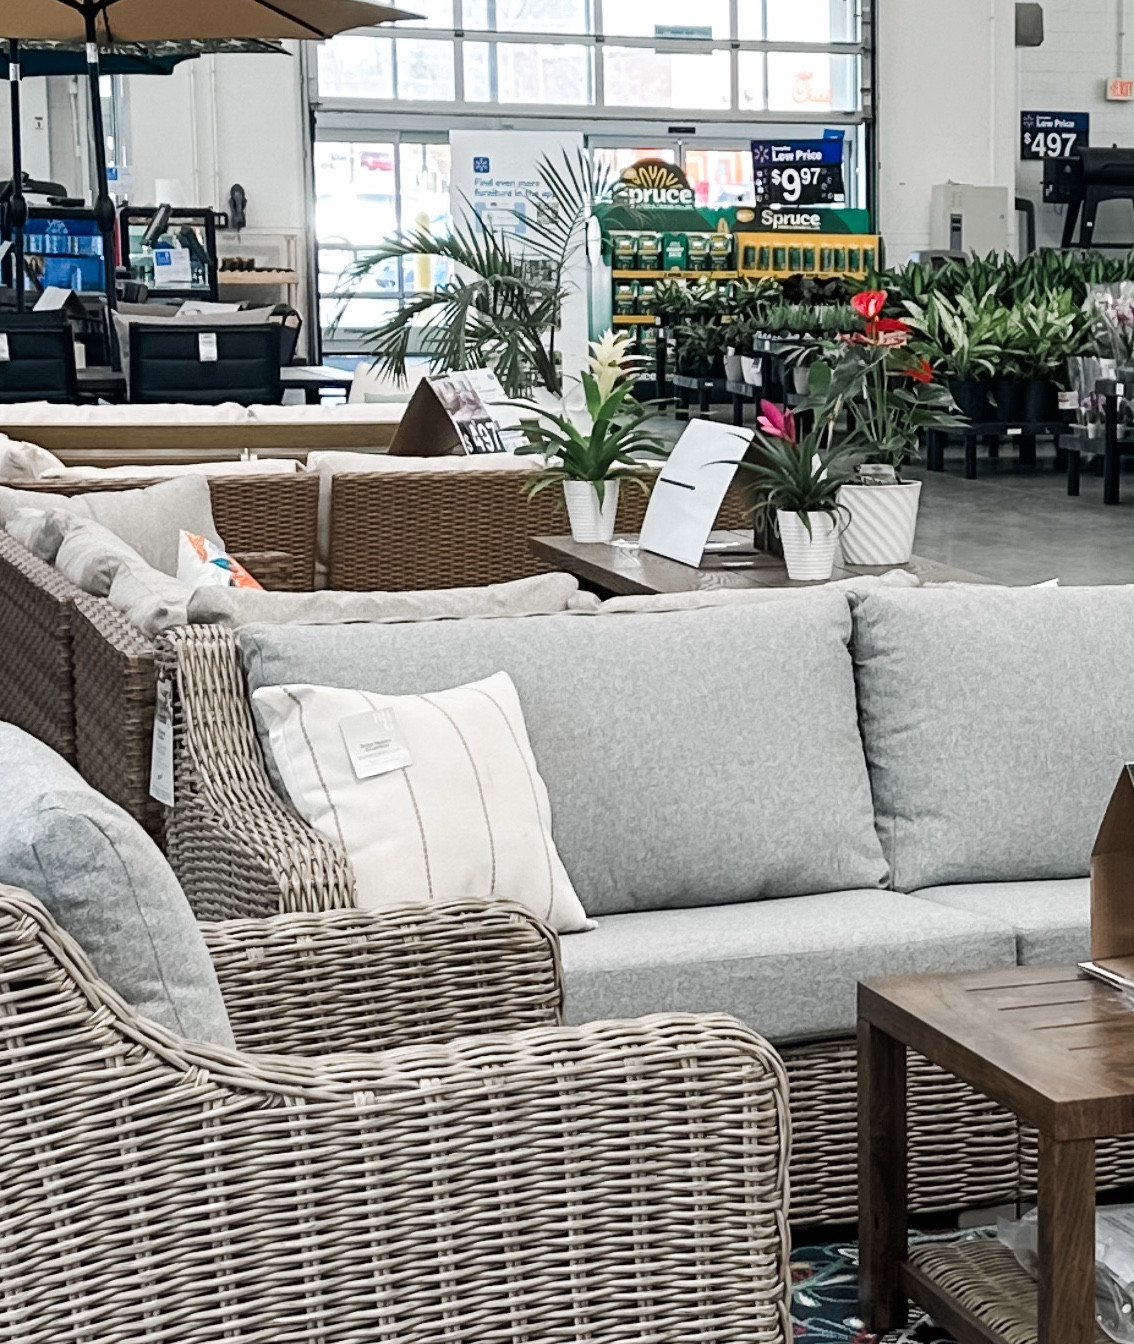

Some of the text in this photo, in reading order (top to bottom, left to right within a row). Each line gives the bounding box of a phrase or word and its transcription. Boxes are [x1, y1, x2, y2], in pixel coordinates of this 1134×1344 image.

[1023, 132, 1077, 157] $497
[771, 149, 823, 162] Low Price
[474, 178, 493, 187] Find
[761, 209, 821, 229] Spruce
